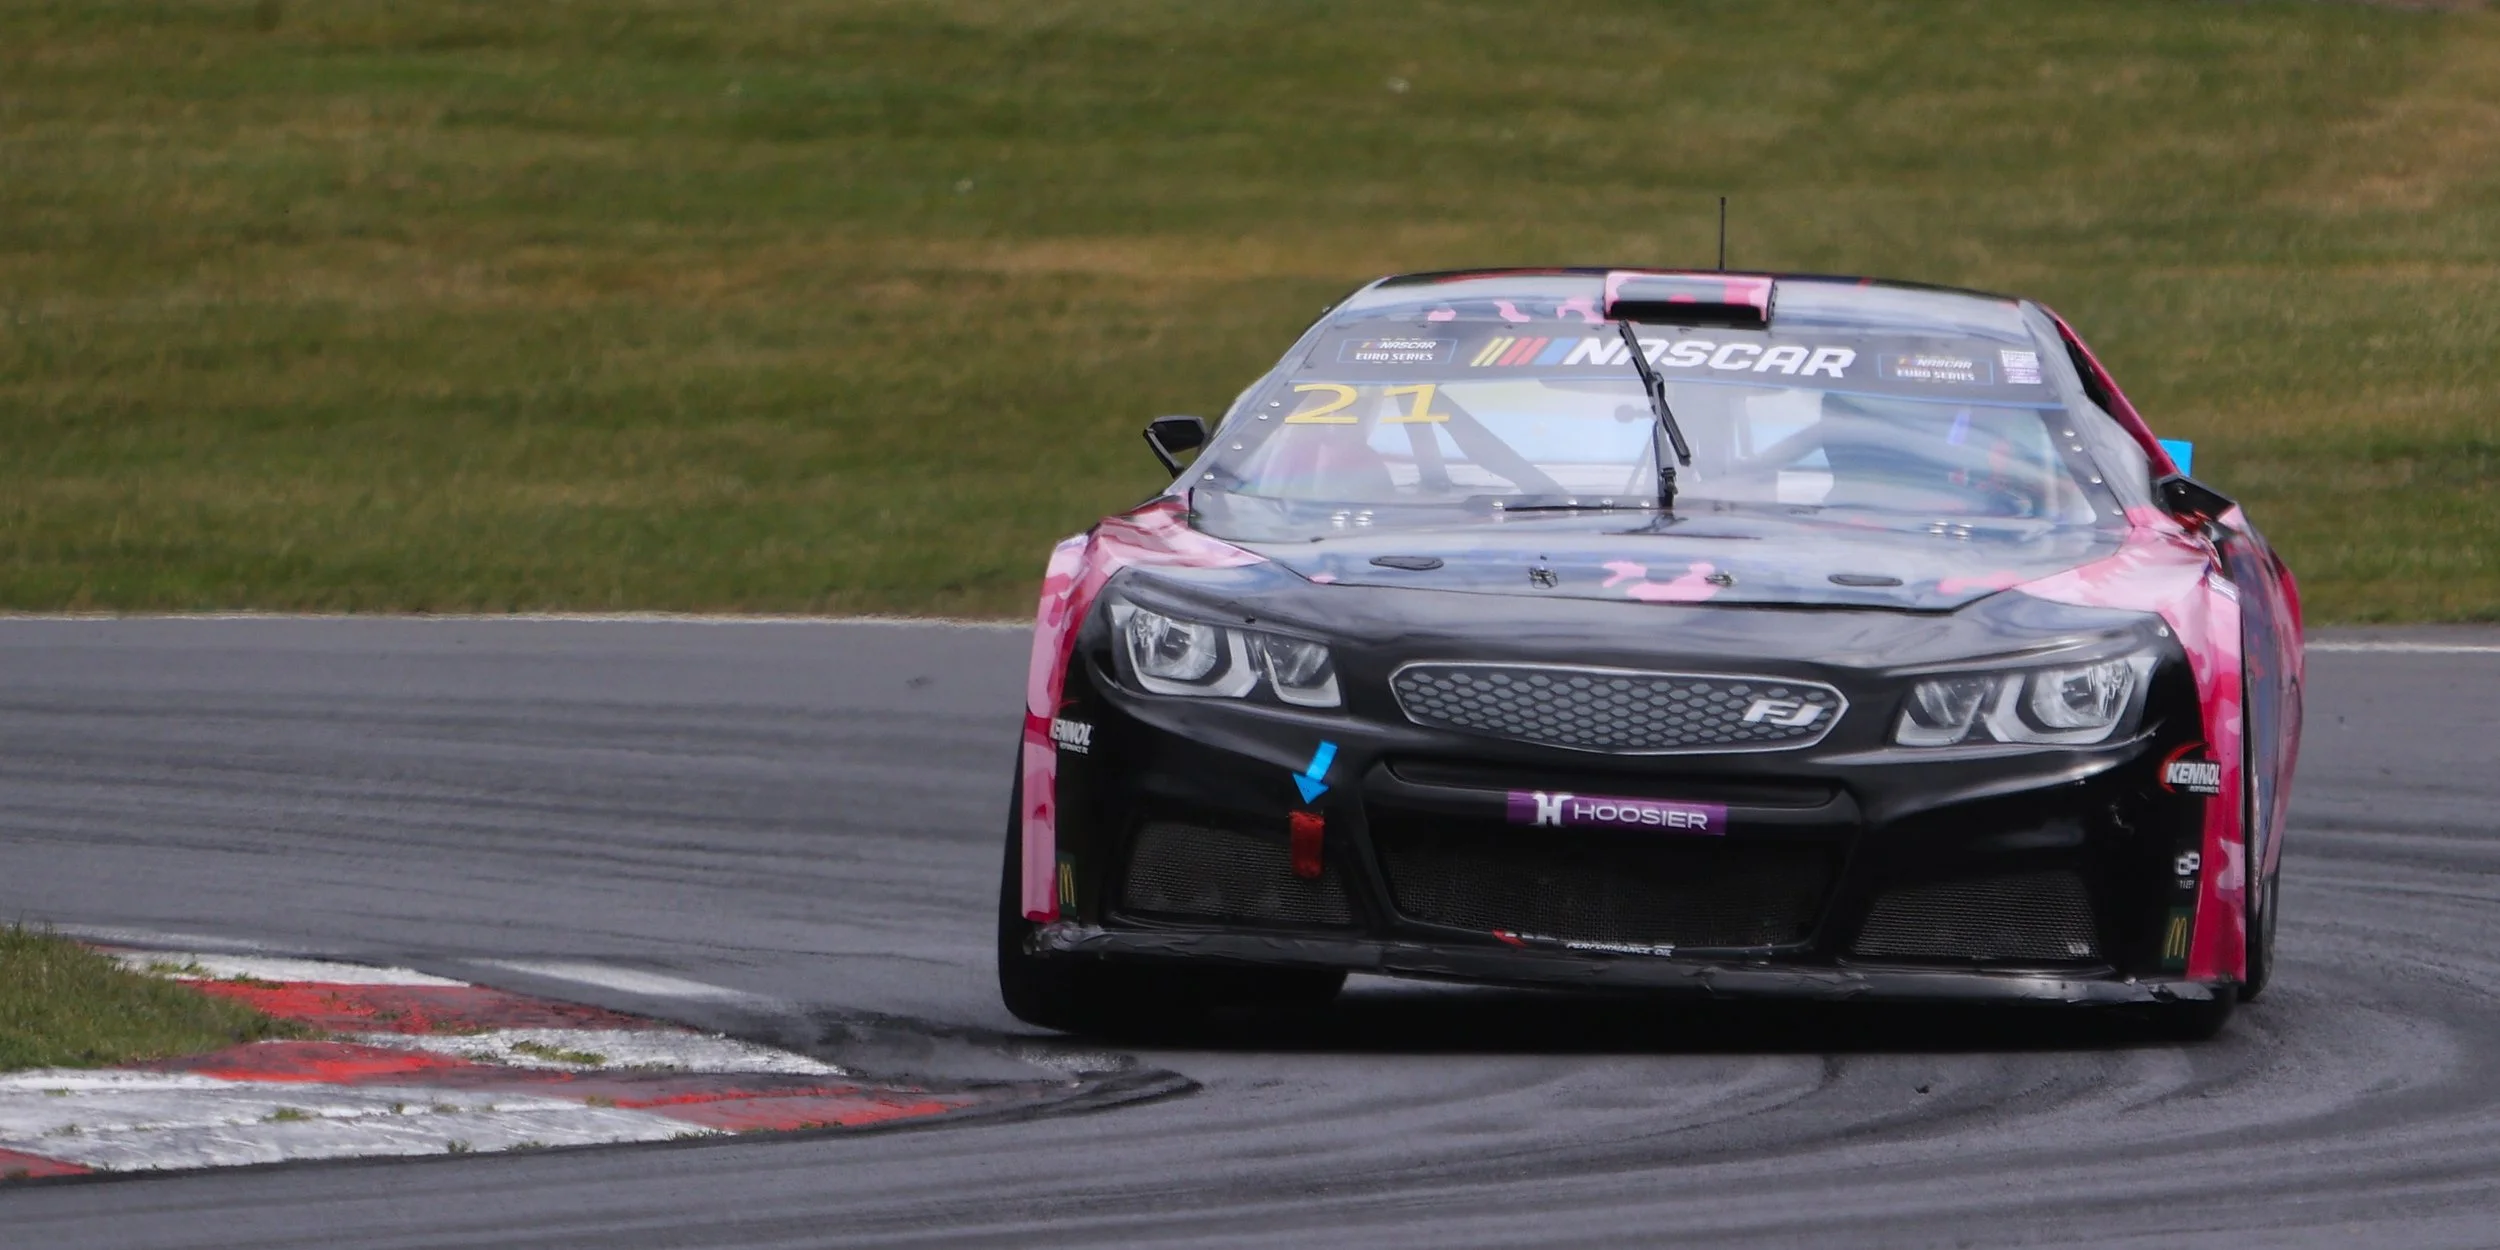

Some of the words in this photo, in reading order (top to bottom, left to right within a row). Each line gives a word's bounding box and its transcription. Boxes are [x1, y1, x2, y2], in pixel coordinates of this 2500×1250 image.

[1355, 352, 1390, 361] EURO
[1391, 352, 1434, 361] SERIES
[1379, 341, 1438, 350] NASCAR
[1563, 337, 1857, 378] NASCAR
[1284, 383, 1450, 424] 21
[2166, 762, 2220, 785] KENNOL
[1574, 803, 1708, 830] HOOSIER
